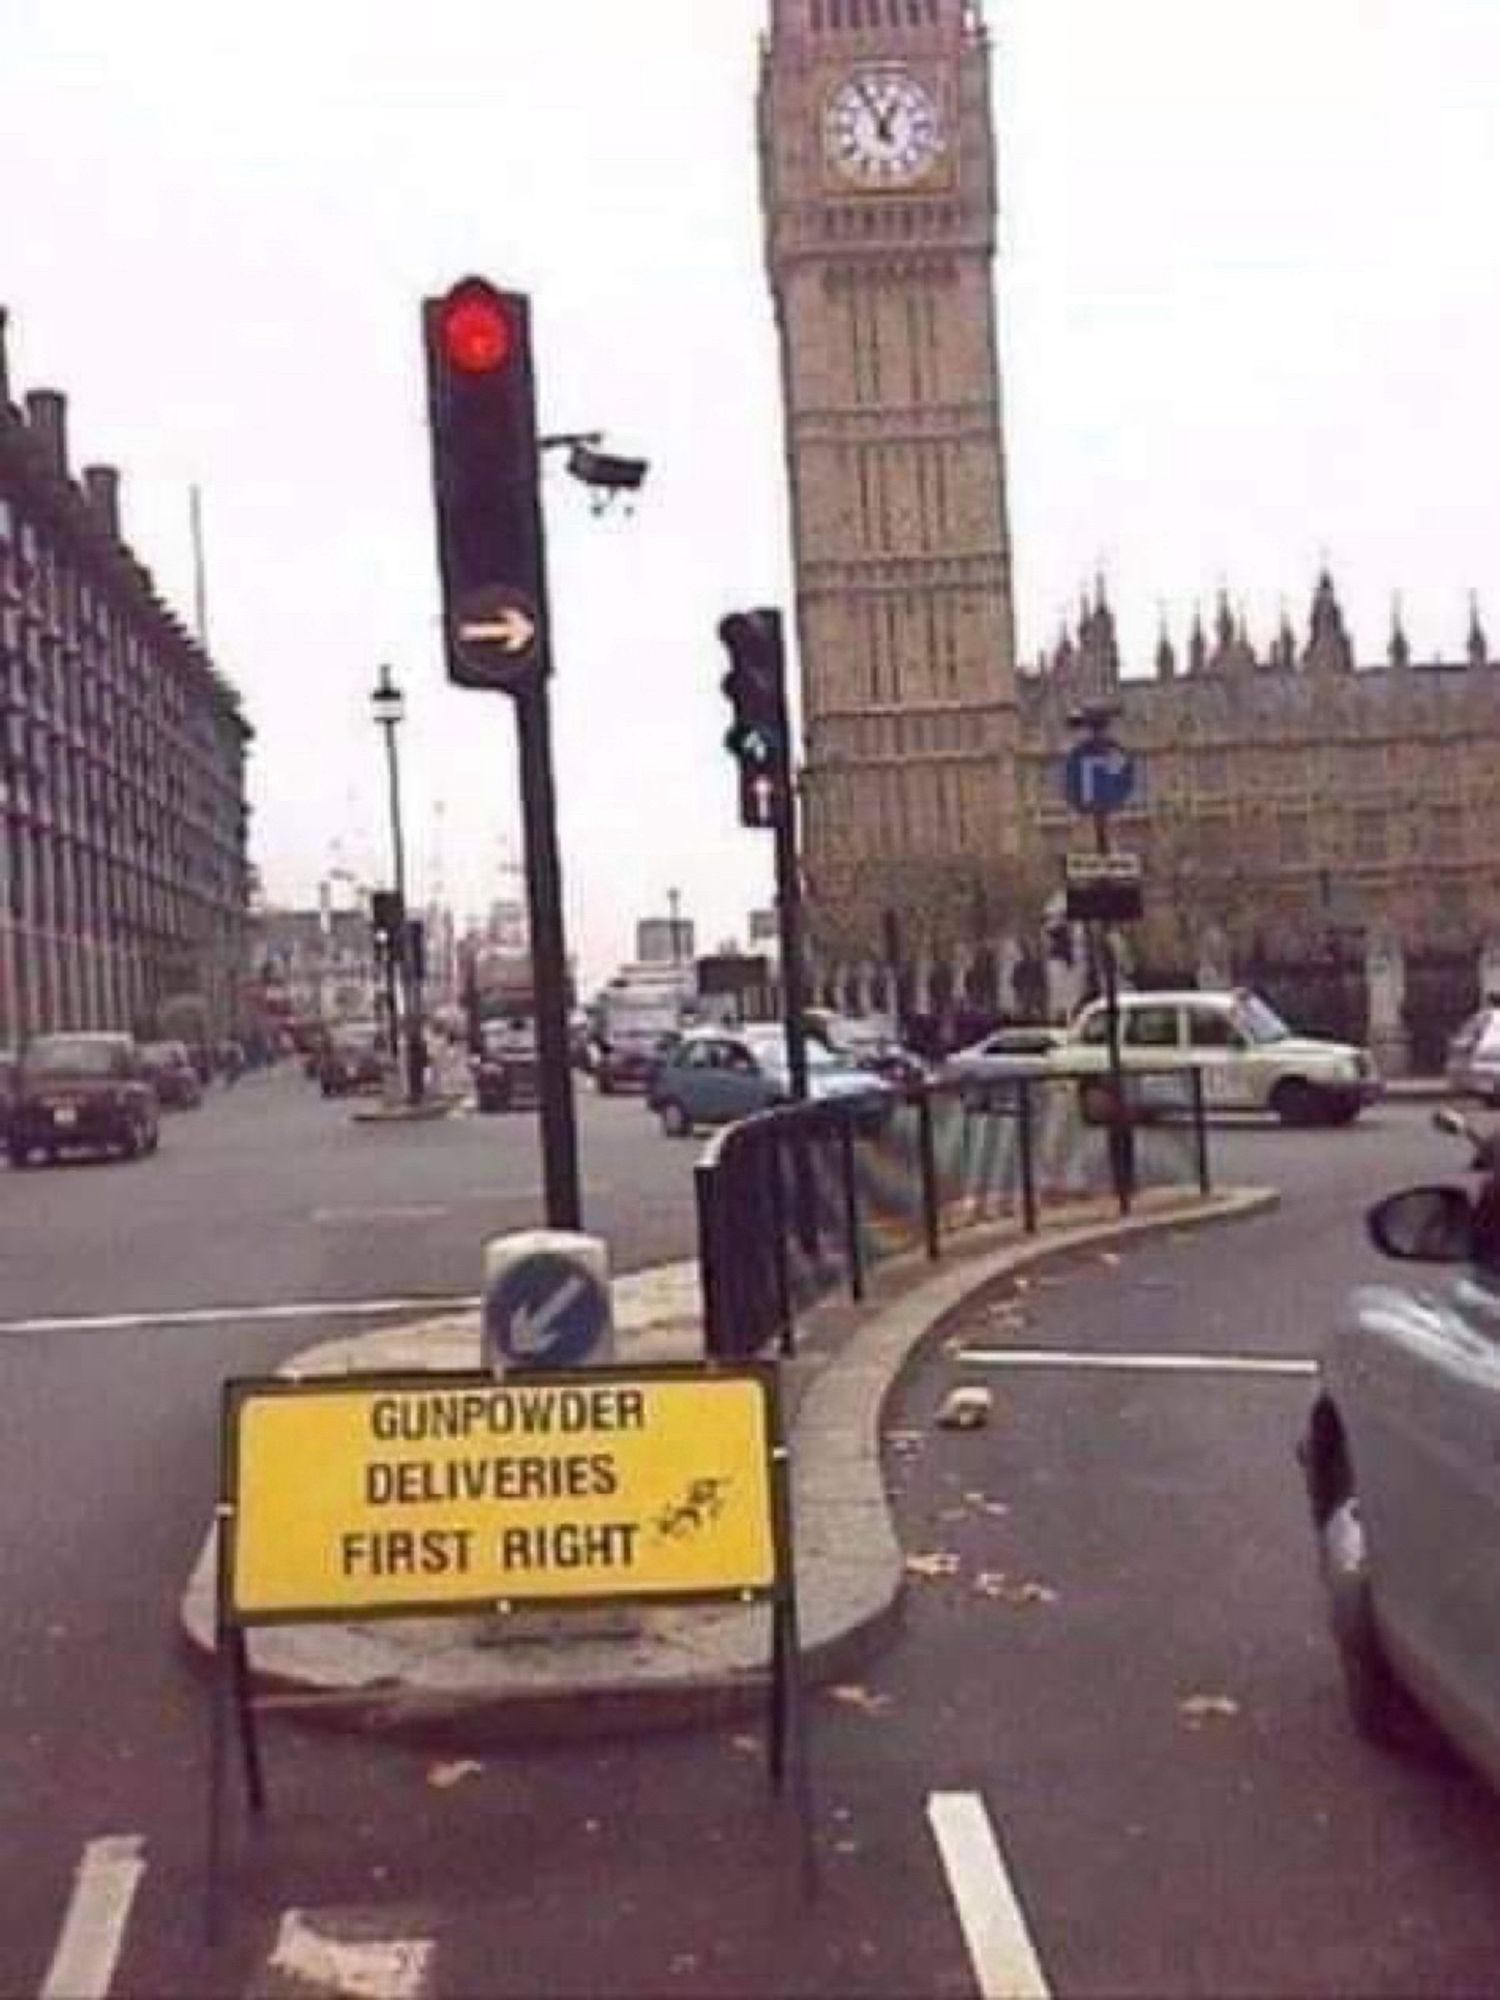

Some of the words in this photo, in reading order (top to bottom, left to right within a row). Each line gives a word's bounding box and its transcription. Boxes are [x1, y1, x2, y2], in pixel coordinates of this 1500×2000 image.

[371, 1389, 645, 1441] GUNPOWDER
[365, 1454, 616, 1504] DELIVERIES
[342, 1530, 475, 1576] FIRST
[503, 1522, 640, 1571] RIGHT
